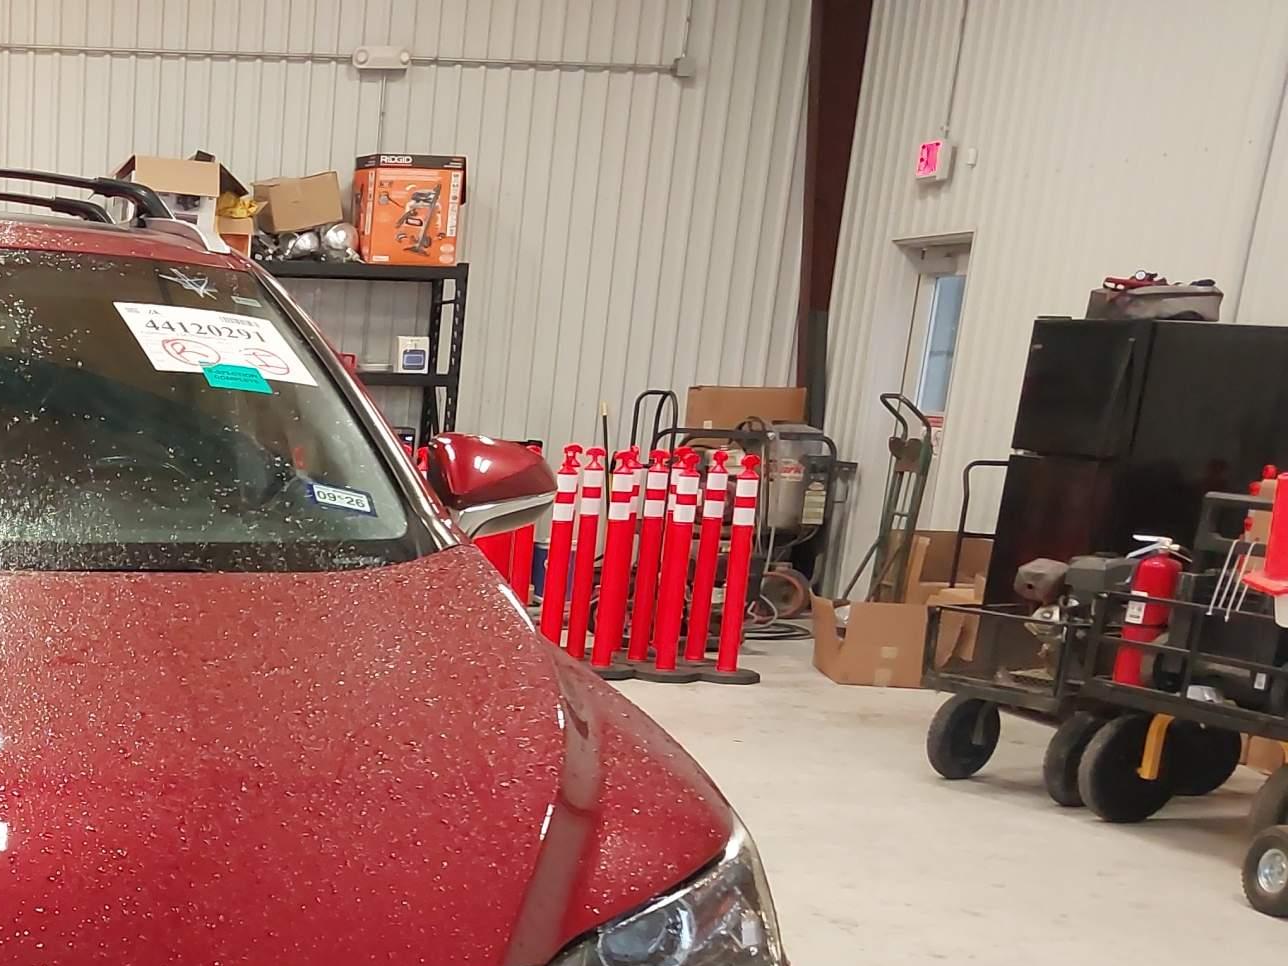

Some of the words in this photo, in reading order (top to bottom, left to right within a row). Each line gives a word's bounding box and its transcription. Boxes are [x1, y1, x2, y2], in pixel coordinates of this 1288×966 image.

[379, 155, 413, 164] RIDGID
[145, 318, 266, 343] 44120291
[316, 490, 365, 508] 09-26
